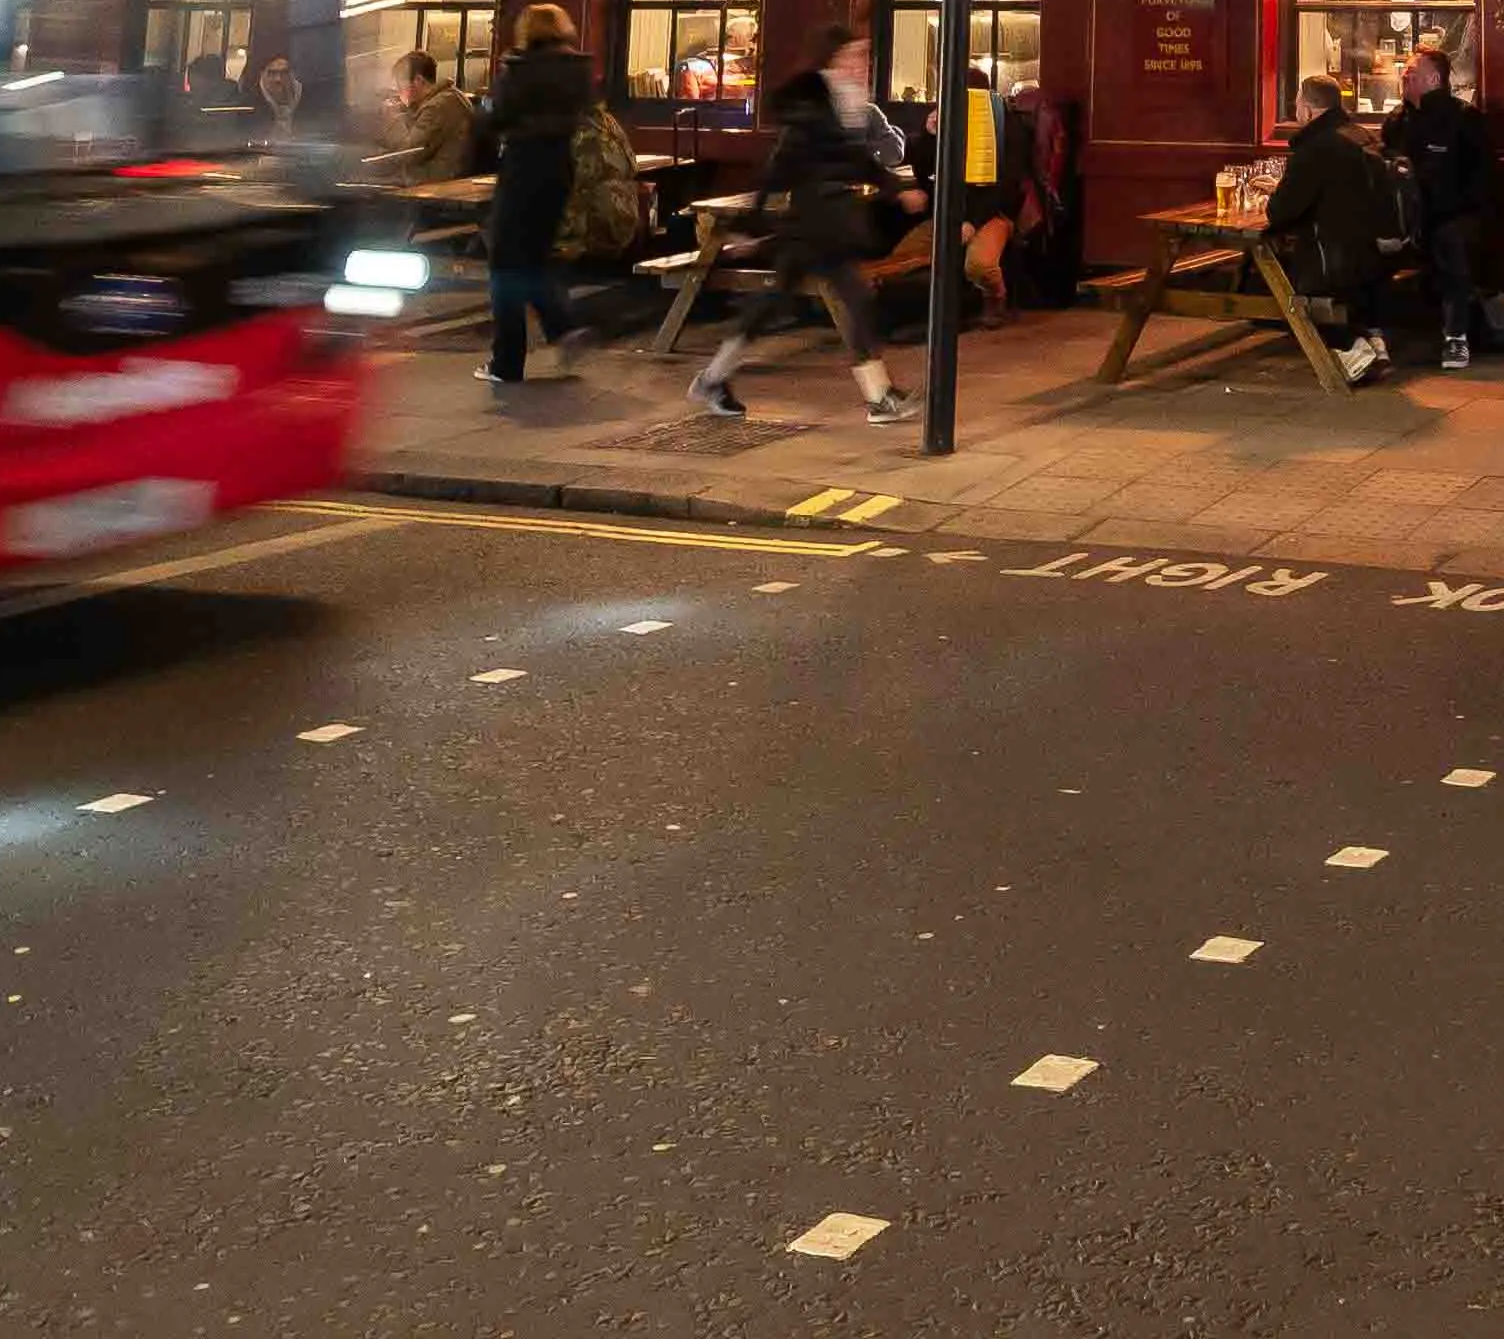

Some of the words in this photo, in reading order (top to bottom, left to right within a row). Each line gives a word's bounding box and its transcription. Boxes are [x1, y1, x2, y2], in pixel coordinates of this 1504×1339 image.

[1156, 26, 1192, 39] GOOD
[1158, 42, 1190, 54] TIMES
[1144, 59, 1177, 71] SINCE
[999, 552, 1329, 597] RIGHT
